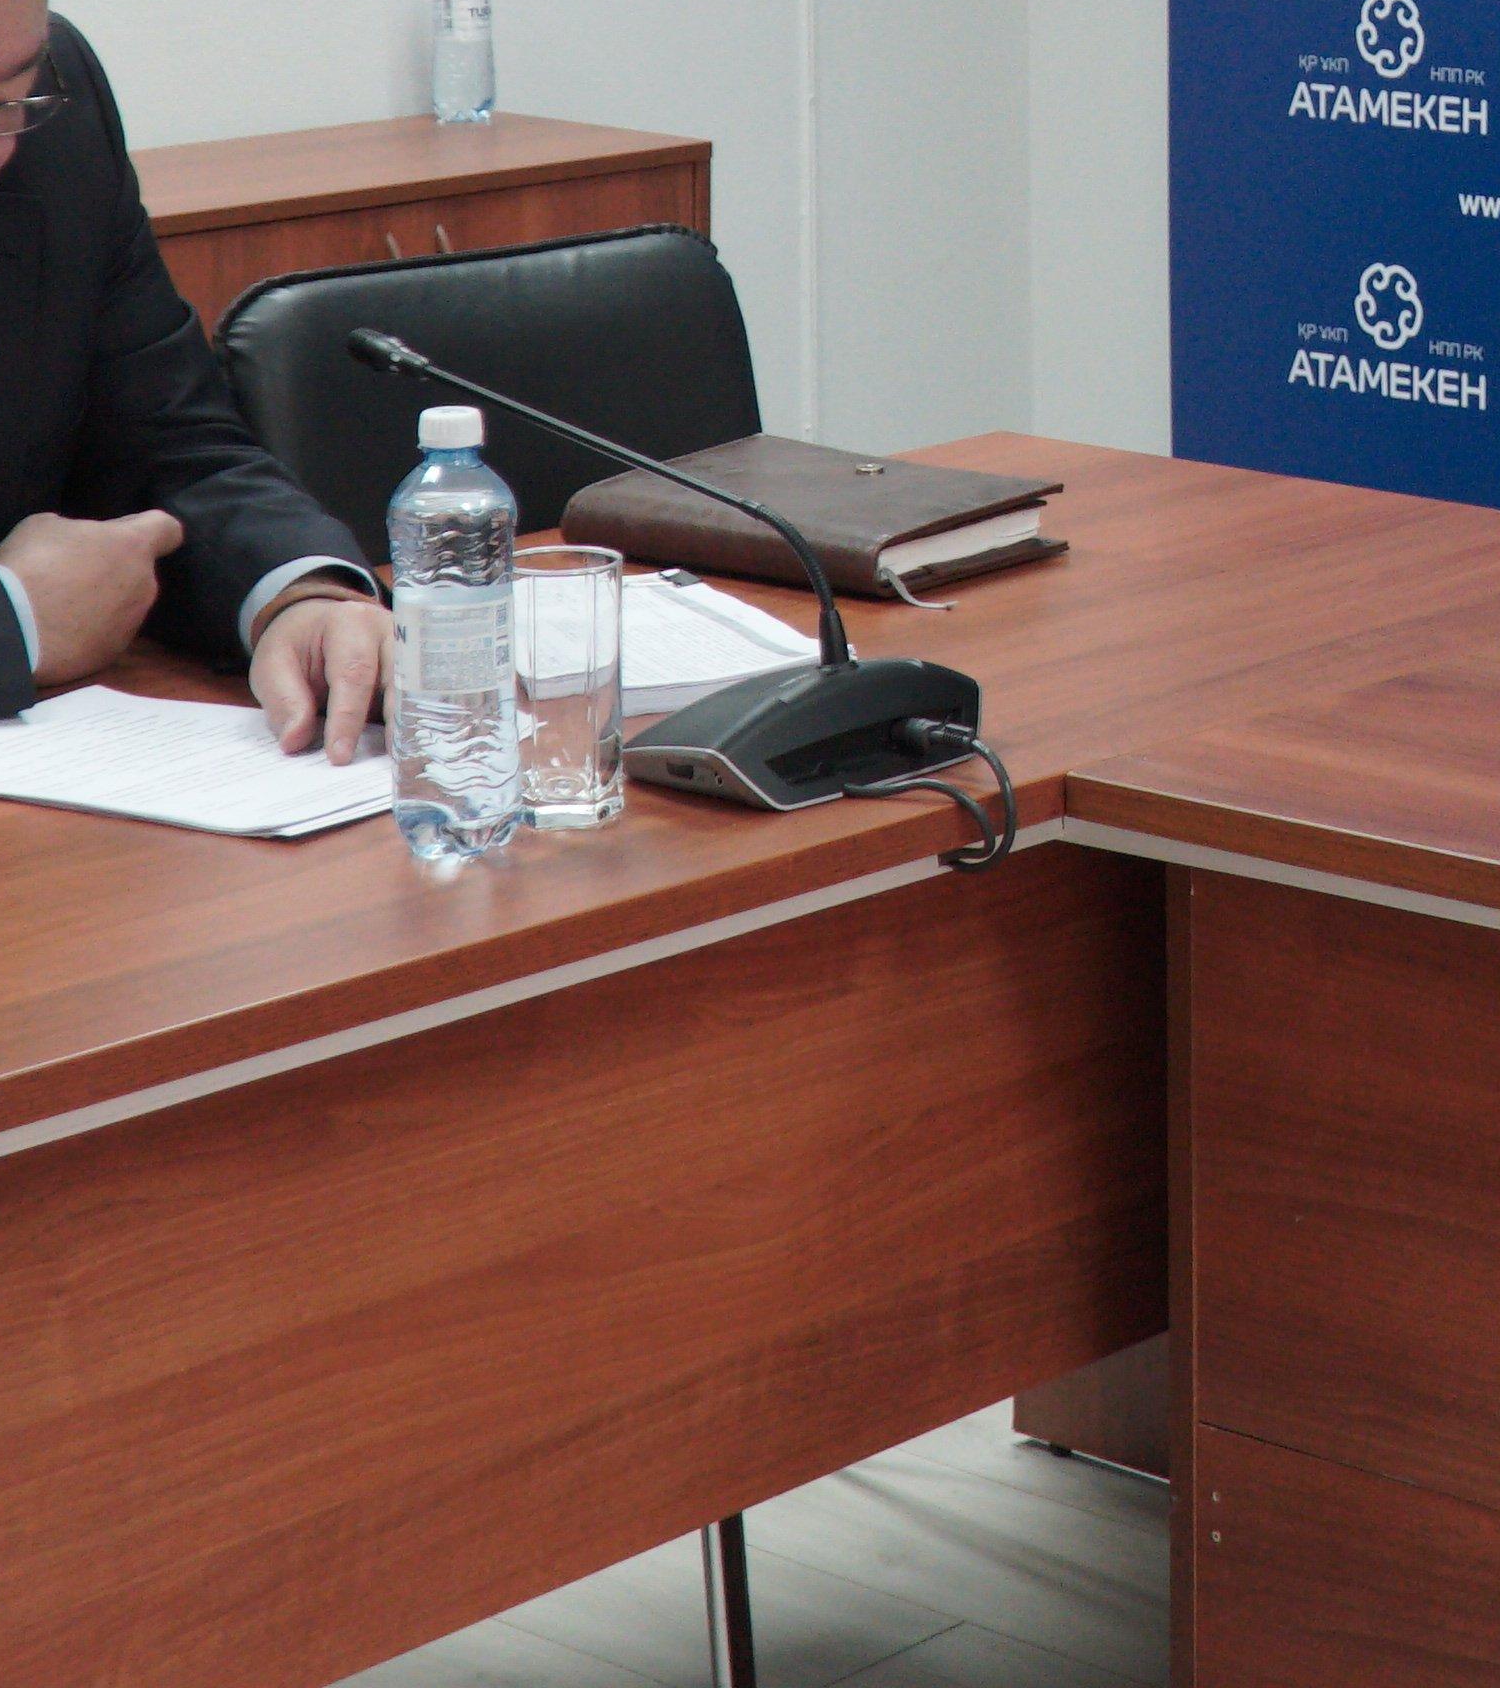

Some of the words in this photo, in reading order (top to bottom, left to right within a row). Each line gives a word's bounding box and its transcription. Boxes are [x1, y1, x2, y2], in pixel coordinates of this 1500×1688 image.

[1430, 65, 1463, 85] НПП
[1462, 68, 1486, 86] РК
[1288, 80, 1489, 136] АТАМЕКЕН
[1428, 339, 1462, 359] НПП
[1462, 342, 1484, 362] РК
[1287, 349, 1488, 411] АТАМЕКЕН
